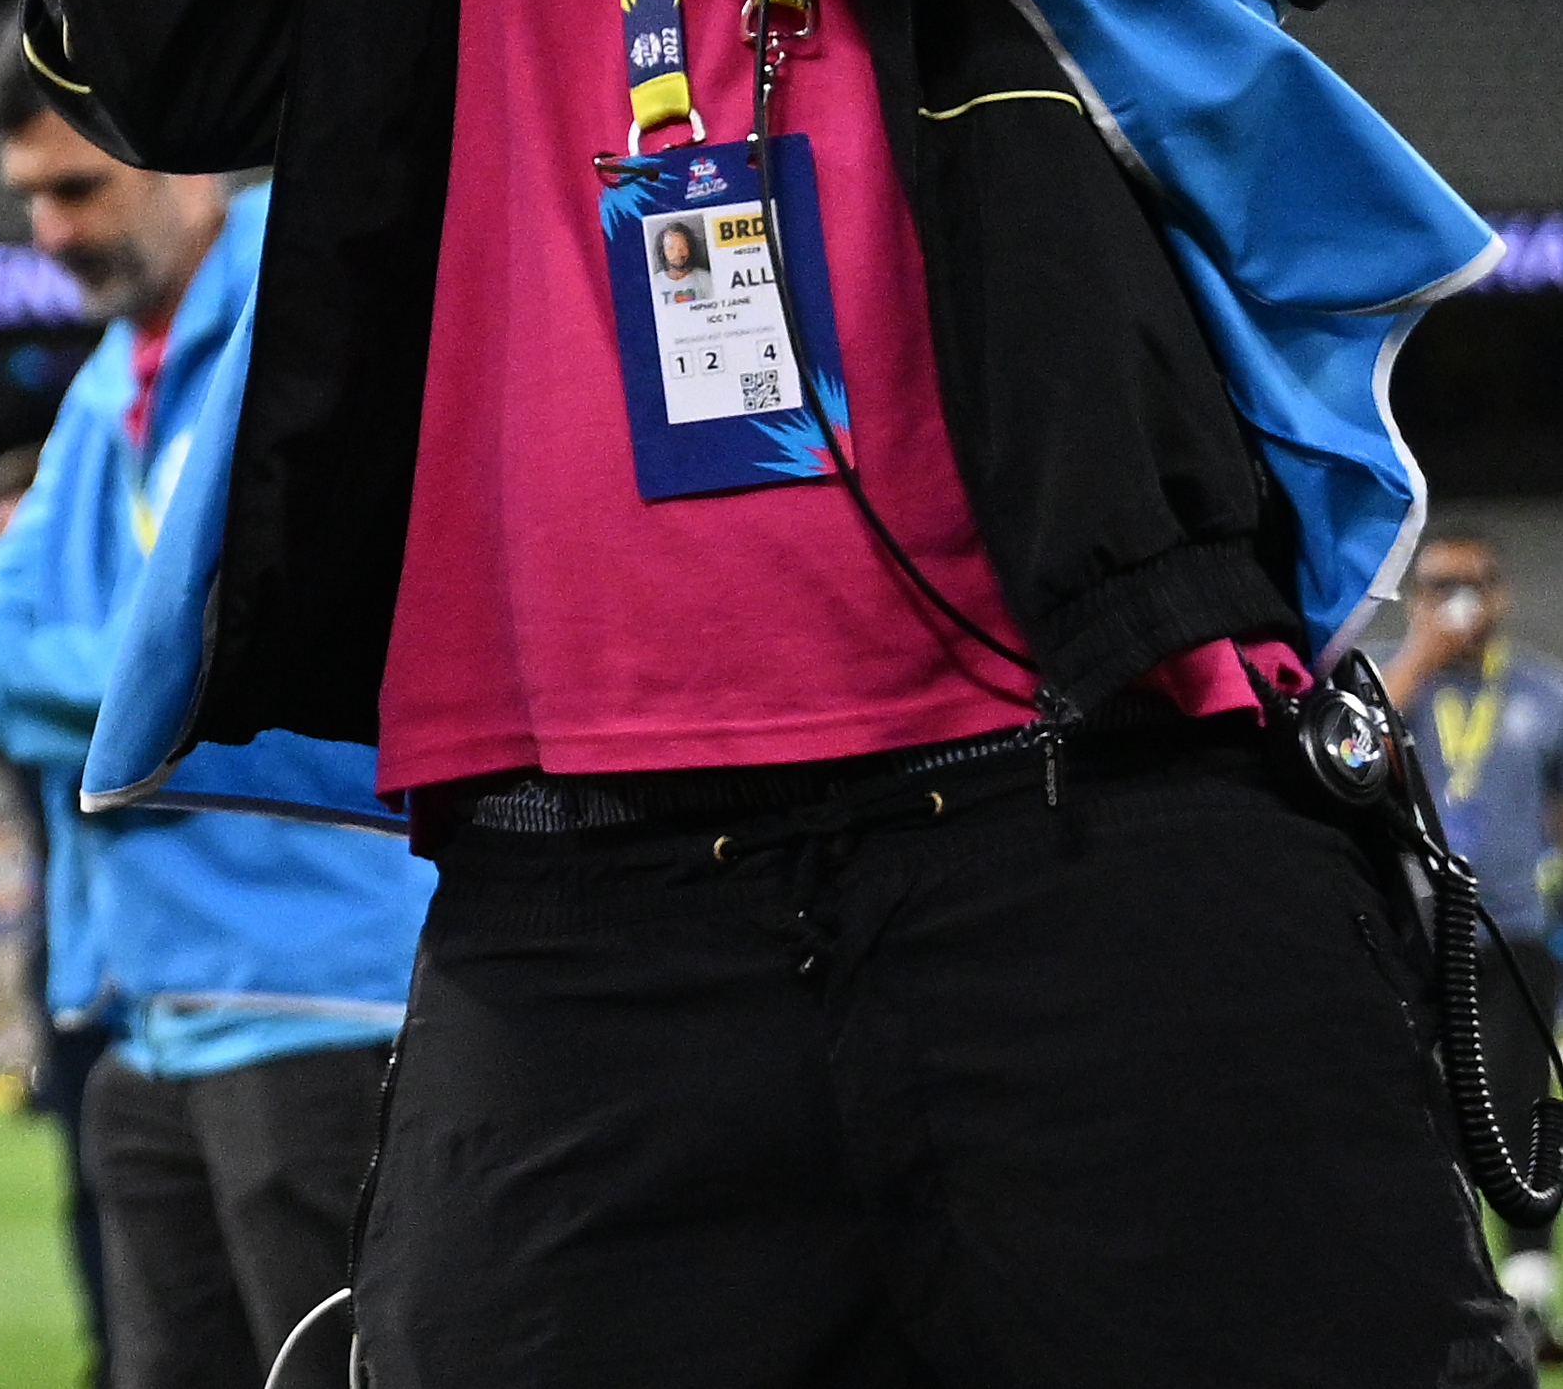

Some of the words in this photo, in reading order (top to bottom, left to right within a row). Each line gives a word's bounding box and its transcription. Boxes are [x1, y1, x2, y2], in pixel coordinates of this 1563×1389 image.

[661, 27, 680, 65] 2022
[730, 267, 775, 289] ALL
[675, 356, 686, 373] 1
[705, 353, 718, 370] 2
[763, 344, 777, 362] 4
